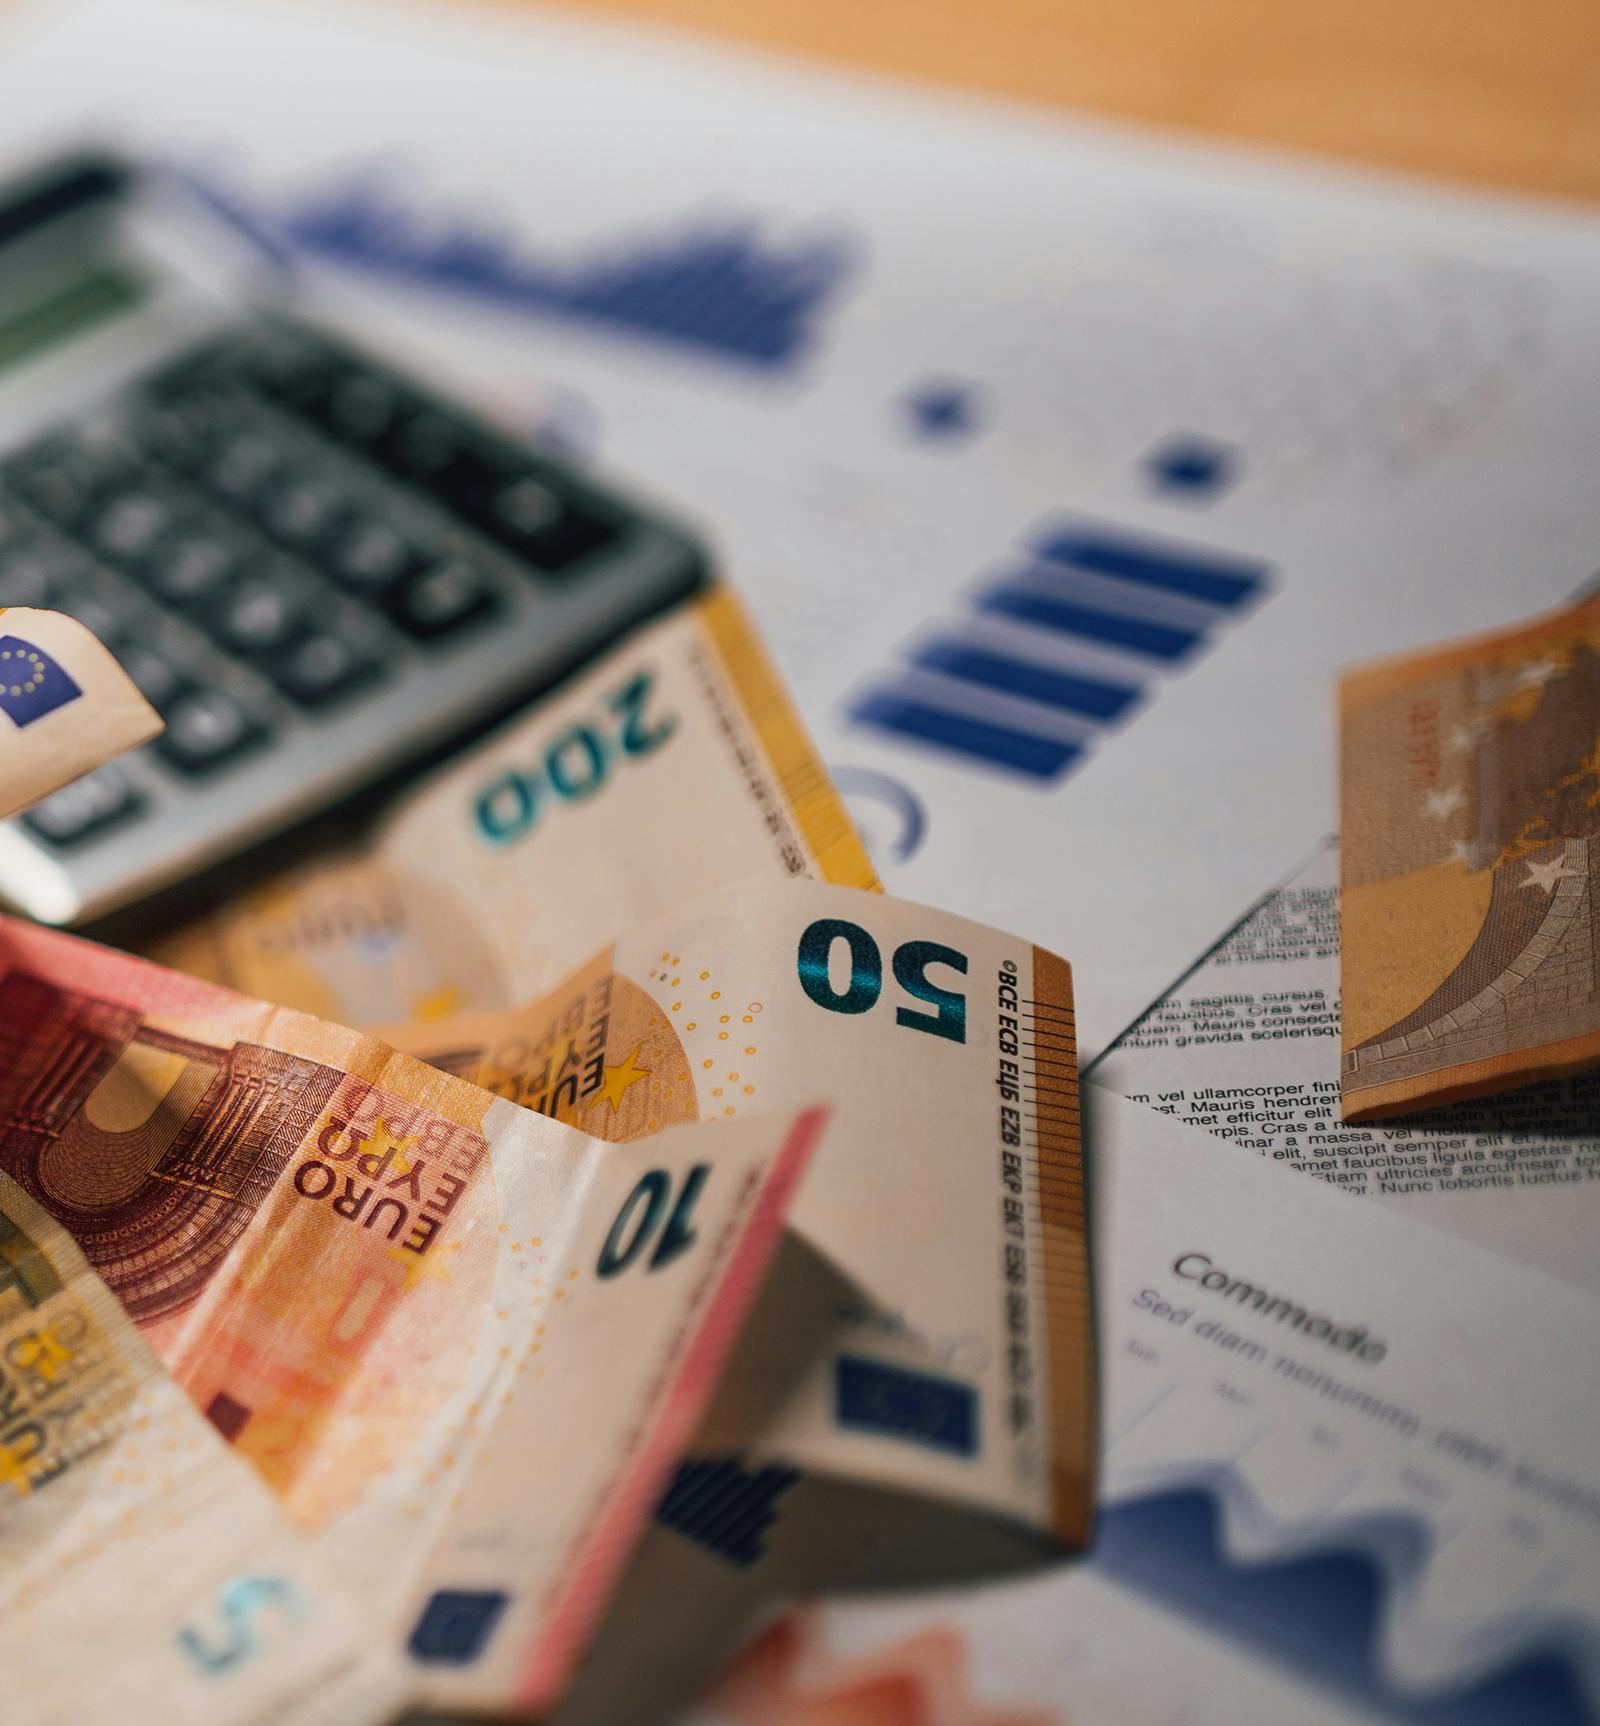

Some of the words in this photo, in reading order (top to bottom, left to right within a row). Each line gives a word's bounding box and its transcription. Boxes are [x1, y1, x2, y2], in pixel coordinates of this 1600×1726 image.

[474, 671, 680, 846] 200
[798, 918, 968, 1044] 50
[1248, 1005, 1293, 1017] Cras
[1300, 1000, 1327, 1012] vel
[999, 1014, 1018, 1056] ECB
[1193, 1018, 1256, 1031] Mauris
[1175, 1031, 1244, 1048] gravida
[1157, 1090, 1186, 1102] vel
[1193, 1083, 1305, 1101] ullamcorper
[1191, 1099, 1256, 1113] Mauris
[1001, 1106, 1021, 1147] EZB
[1177, 1115, 1219, 1126] met
[1226, 1109, 1296, 1123] efficitur
[1304, 1106, 1334, 1119] elit
[1209, 1126, 1254, 1140] rpis.
[1261, 1121, 1308, 1135] Cras
[1314, 1121, 1326, 1131] a
[1236, 1136, 1274, 1149] inar
[1285, 1137, 1298, 1147] a
[1308, 1131, 1374, 1145] massa
[1384, 1126, 1412, 1140] vel
[1273, 1148, 1307, 1161] elit,
[1312, 1142, 1393, 1159] suscipit
[1394, 1137, 1469, 1155] semper
[1475, 1134, 1505, 1148] elit
[1343, 1153, 1428, 1170] faucibus
[1433, 1149, 1486, 1166] ligula
[1492, 1143, 1575, 1161] egestas
[1002, 1150, 1023, 1195] EKP
[1376, 1164, 1454, 1182] ultricies
[1462, 1158, 1567, 1176] accumsan
[1381, 1180, 1434, 1194] Nunc
[1440, 1174, 1515, 1191] lobortis
[1520, 1167, 1583, 1186] luctus
[294, 1160, 443, 1256] EURO
[595, 1161, 712, 1280] 10
[1172, 1252, 1389, 1365] Commodo
[1131, 1288, 1196, 1327] Sed
[1195, 1319, 1269, 1363] diam
[175, 1572, 312, 1680] 5
